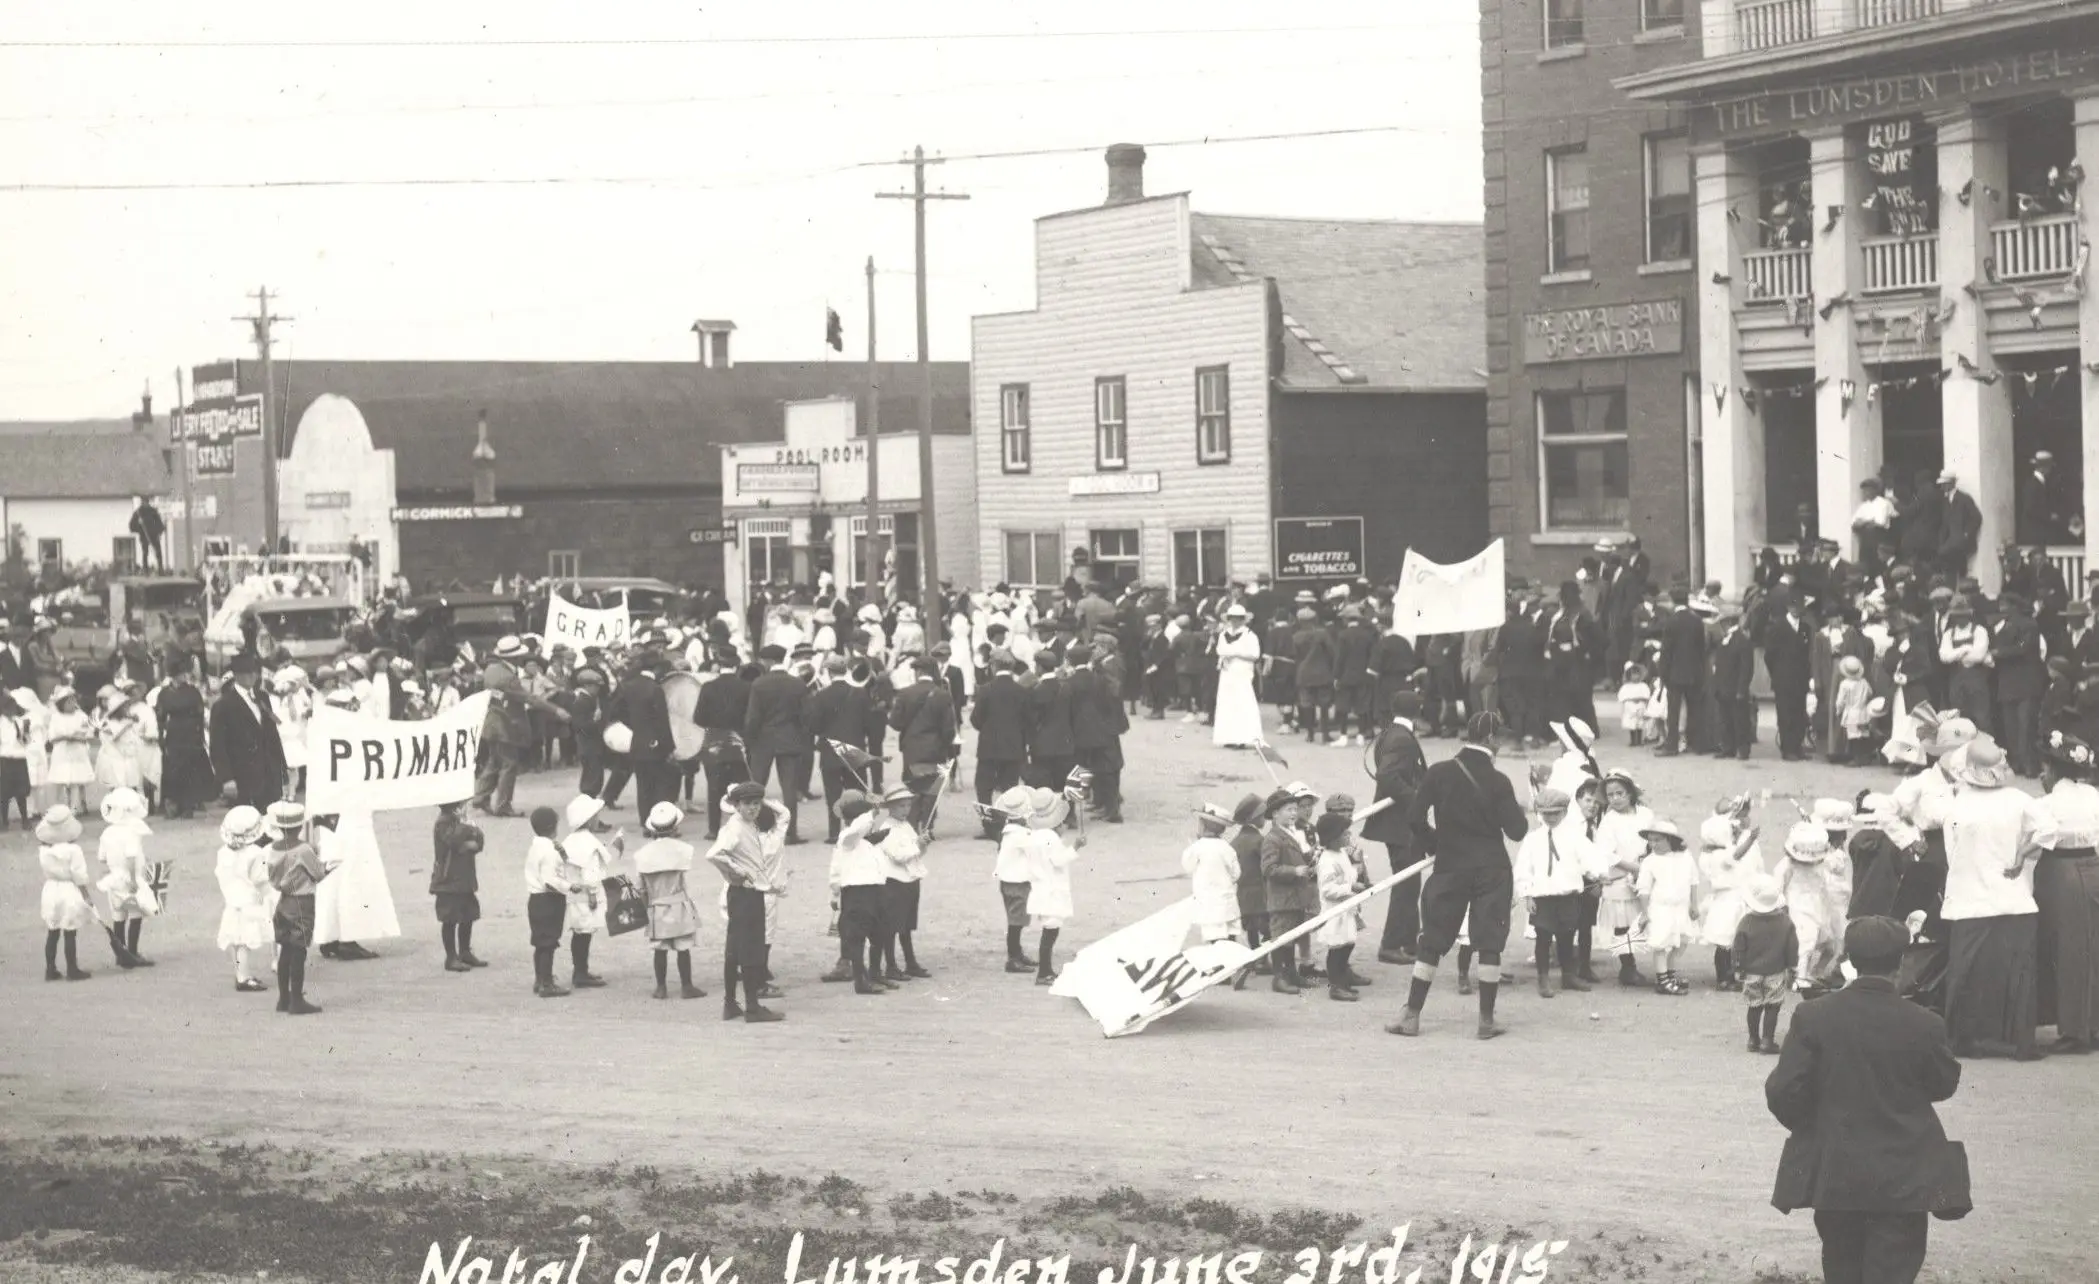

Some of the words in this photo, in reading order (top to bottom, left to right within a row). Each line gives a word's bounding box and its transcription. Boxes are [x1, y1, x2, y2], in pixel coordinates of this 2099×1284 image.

[1712, 100, 1770, 132] THE
[1789, 75, 1938, 120] LUMSDEN
[1867, 120, 1911, 149] GOD
[1867, 148, 1912, 174] SAVE
[1526, 313, 1555, 338] THE
[1562, 307, 1621, 333] ROYAL
[1628, 300, 1680, 327] BANK
[1546, 335, 1568, 358] OF
[1574, 327, 1656, 354] CANADA
[776, 449, 813, 465] POOL
[822, 445, 864, 463] ROOM
[1287, 551, 1351, 563] CIGARETTES
[1303, 562, 1357, 574] TOBACCO
[330, 725, 479, 782] PRIMARY
